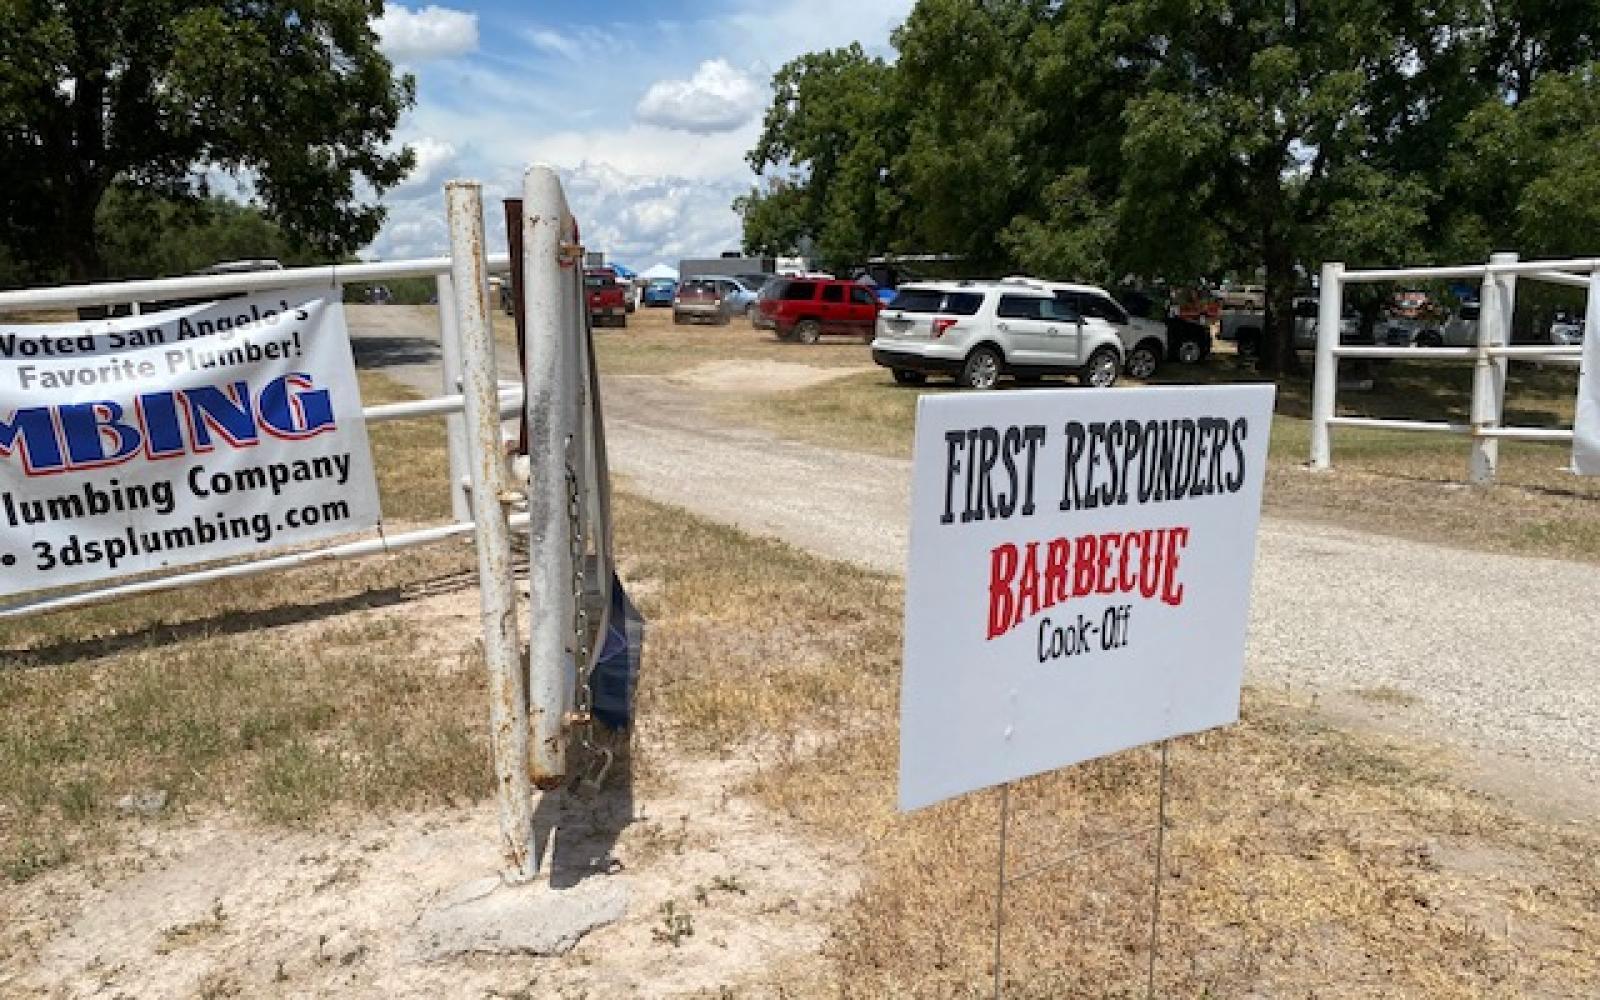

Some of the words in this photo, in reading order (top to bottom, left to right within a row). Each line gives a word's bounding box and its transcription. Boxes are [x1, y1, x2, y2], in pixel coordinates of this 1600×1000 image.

[109, 326, 164, 349] San
[177, 299, 309, 340] Angelo's
[17, 357, 156, 391] Favorite
[165, 332, 302, 376] Plumber!
[188, 452, 350, 495] Company
[940, 424, 1047, 525] FIRST
[1059, 416, 1248, 511] RESPONDERS
[32, 498, 349, 571] 3dsplumbing.com
[985, 527, 1190, 641] BARBECUE
[1037, 604, 1133, 663] Cook-Off
